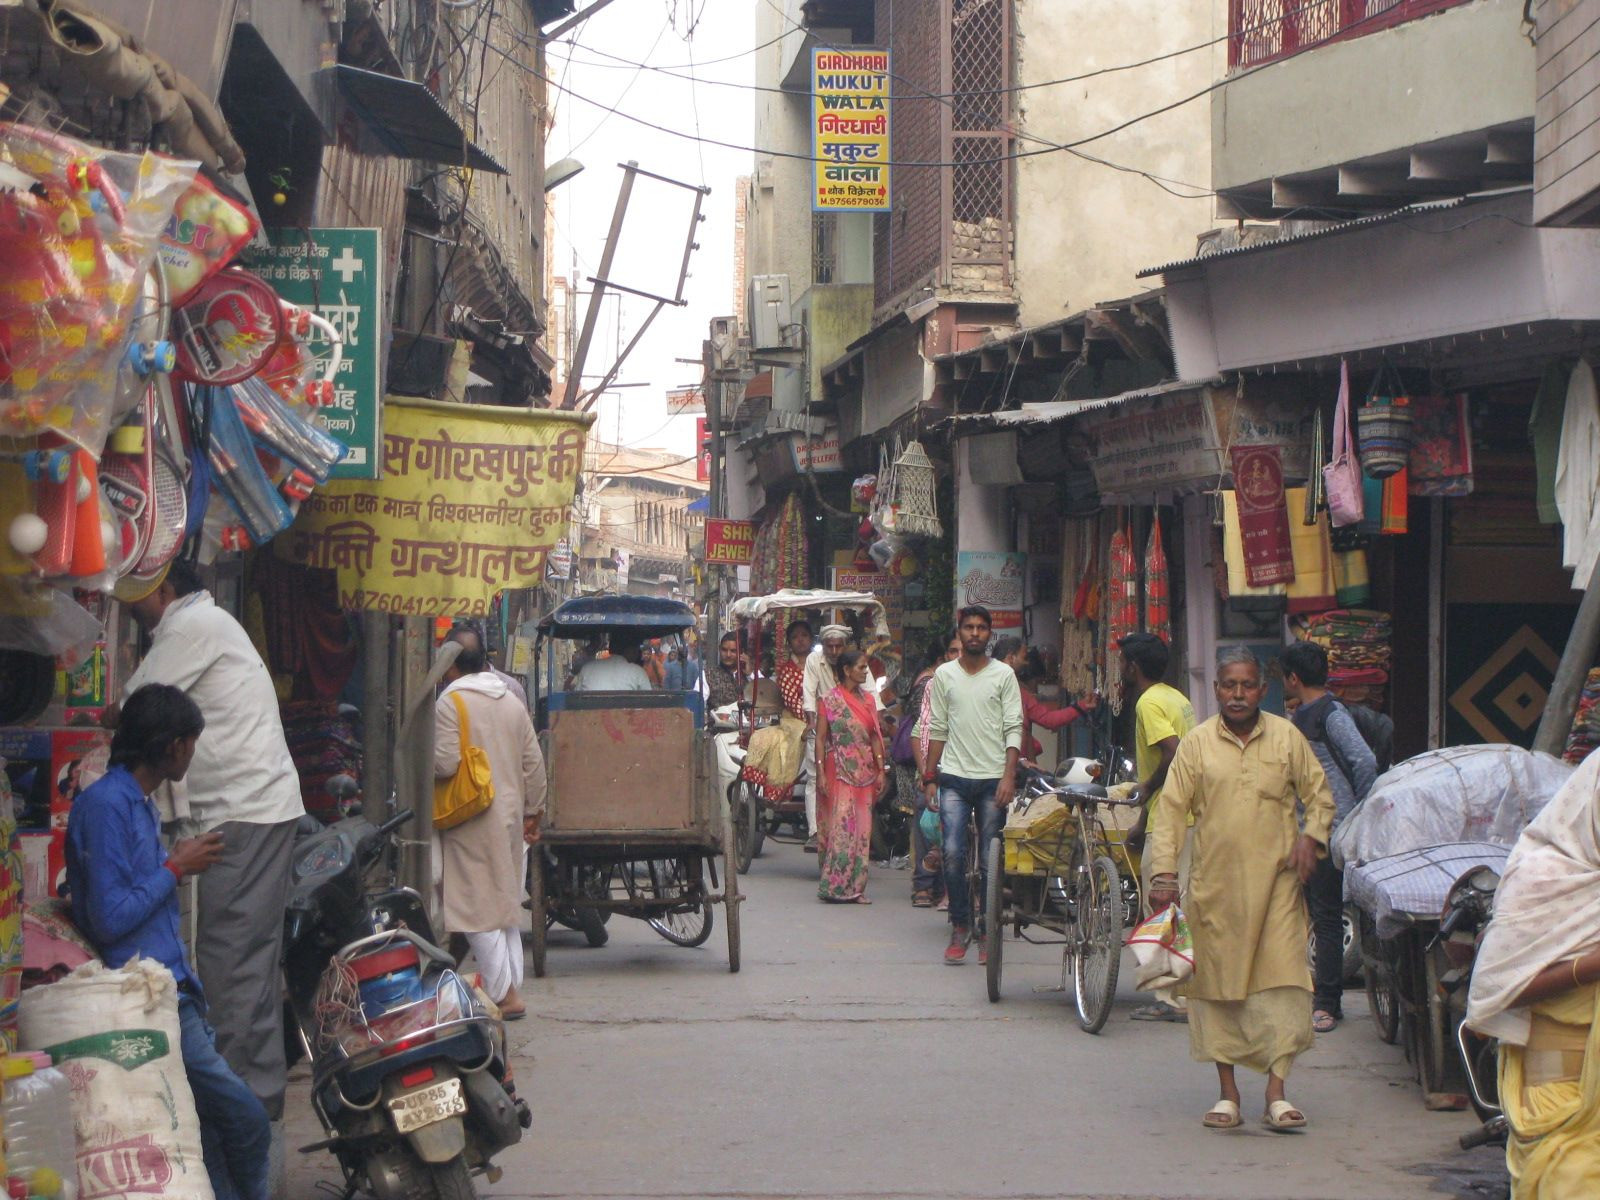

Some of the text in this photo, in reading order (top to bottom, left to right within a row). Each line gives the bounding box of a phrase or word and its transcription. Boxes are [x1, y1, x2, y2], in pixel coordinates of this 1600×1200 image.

[817, 55, 887, 70] GIRDHARI
[818, 74, 886, 90] MUKUT
[821, 95, 884, 110] WALA
[818, 114, 886, 135] गिरधारी
[822, 143, 880, 164] मुकुट
[824, 166, 880, 182] वाला
[827, 184, 845, 195] थोक
[415, 428, 547, 498] गोरखपुर
[547, 429, 586, 483] की
[353, 493, 379, 515] एक
[427, 494, 525, 526] विश्वसनीय
